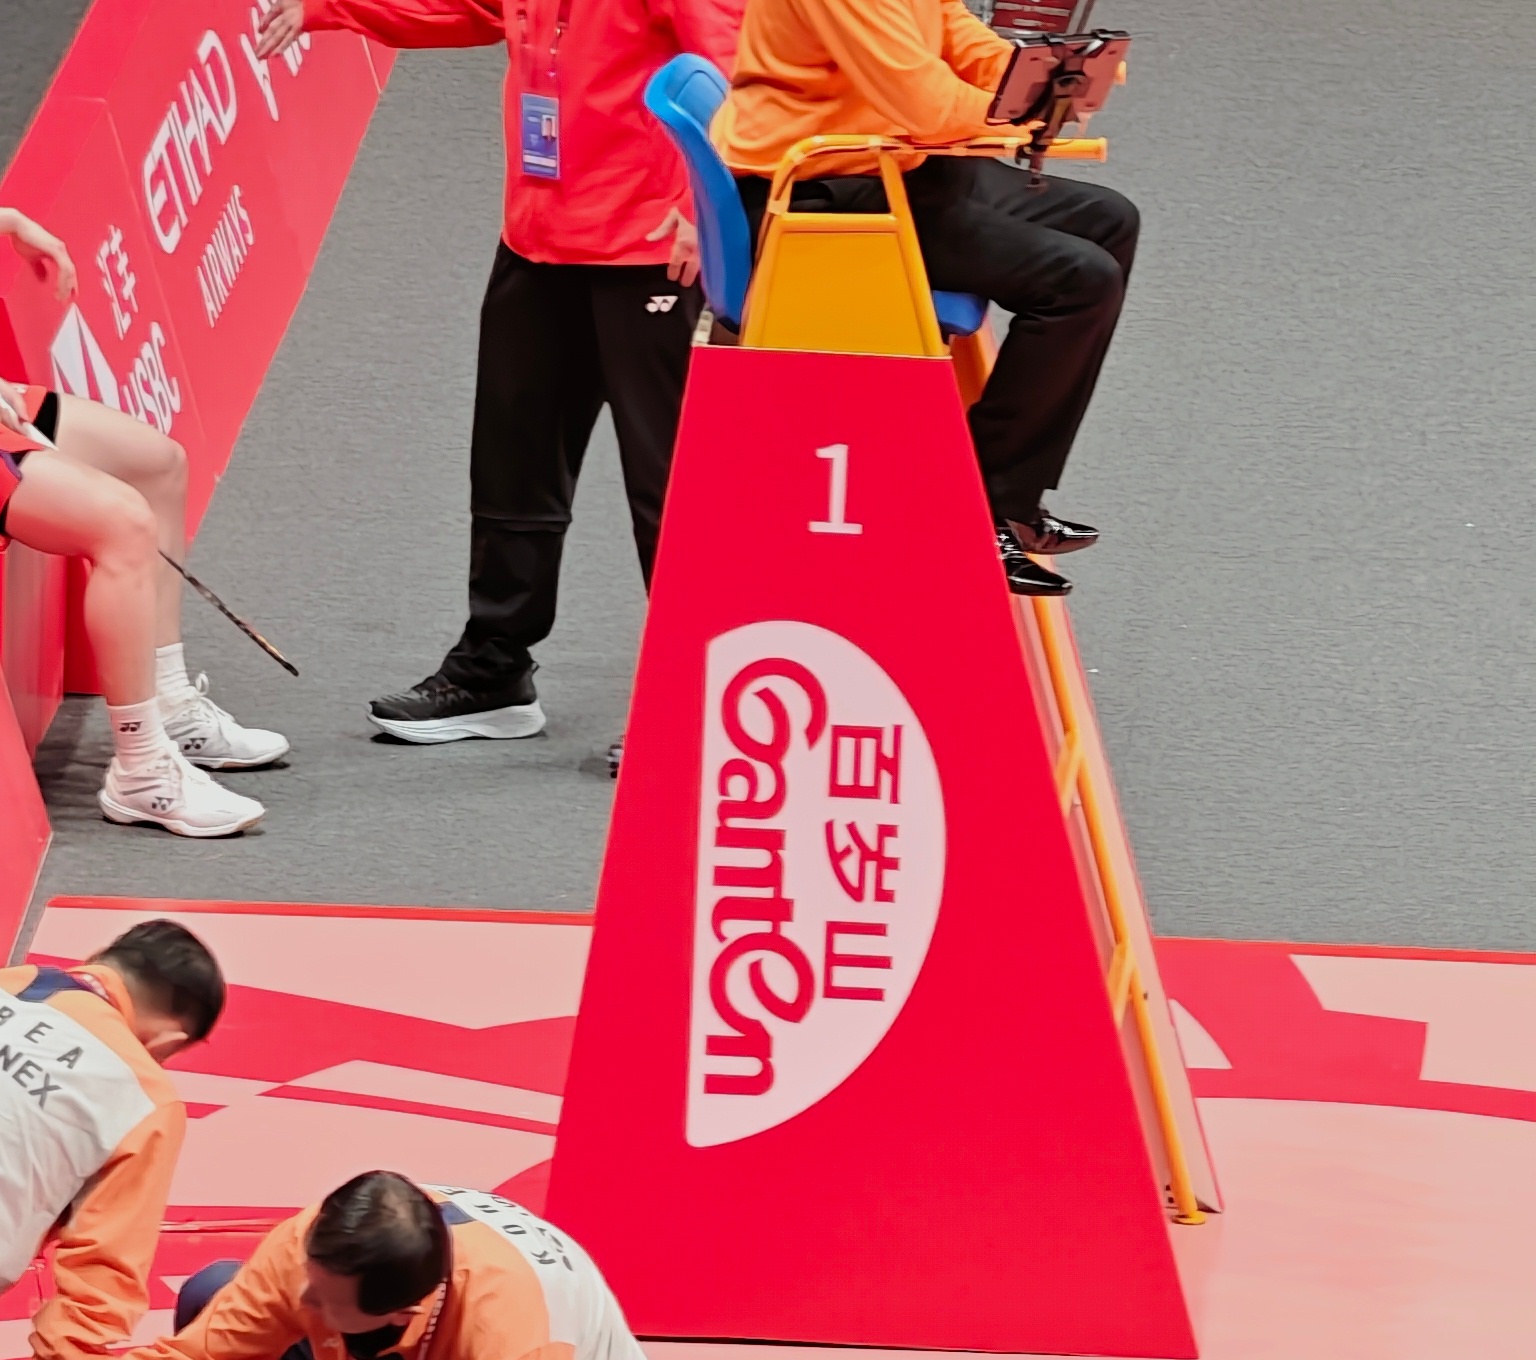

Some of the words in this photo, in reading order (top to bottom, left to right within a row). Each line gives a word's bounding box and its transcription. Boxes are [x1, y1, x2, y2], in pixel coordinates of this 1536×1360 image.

[142, 29, 238, 255] ETIHAD
[96, 224, 139, 340] 汇丰
[196, 185, 254, 329] AIRWAYS
[808, 443, 863, 535] 1
[703, 657, 827, 1095] Ganten
[824, 724, 904, 1002] 百岁山
